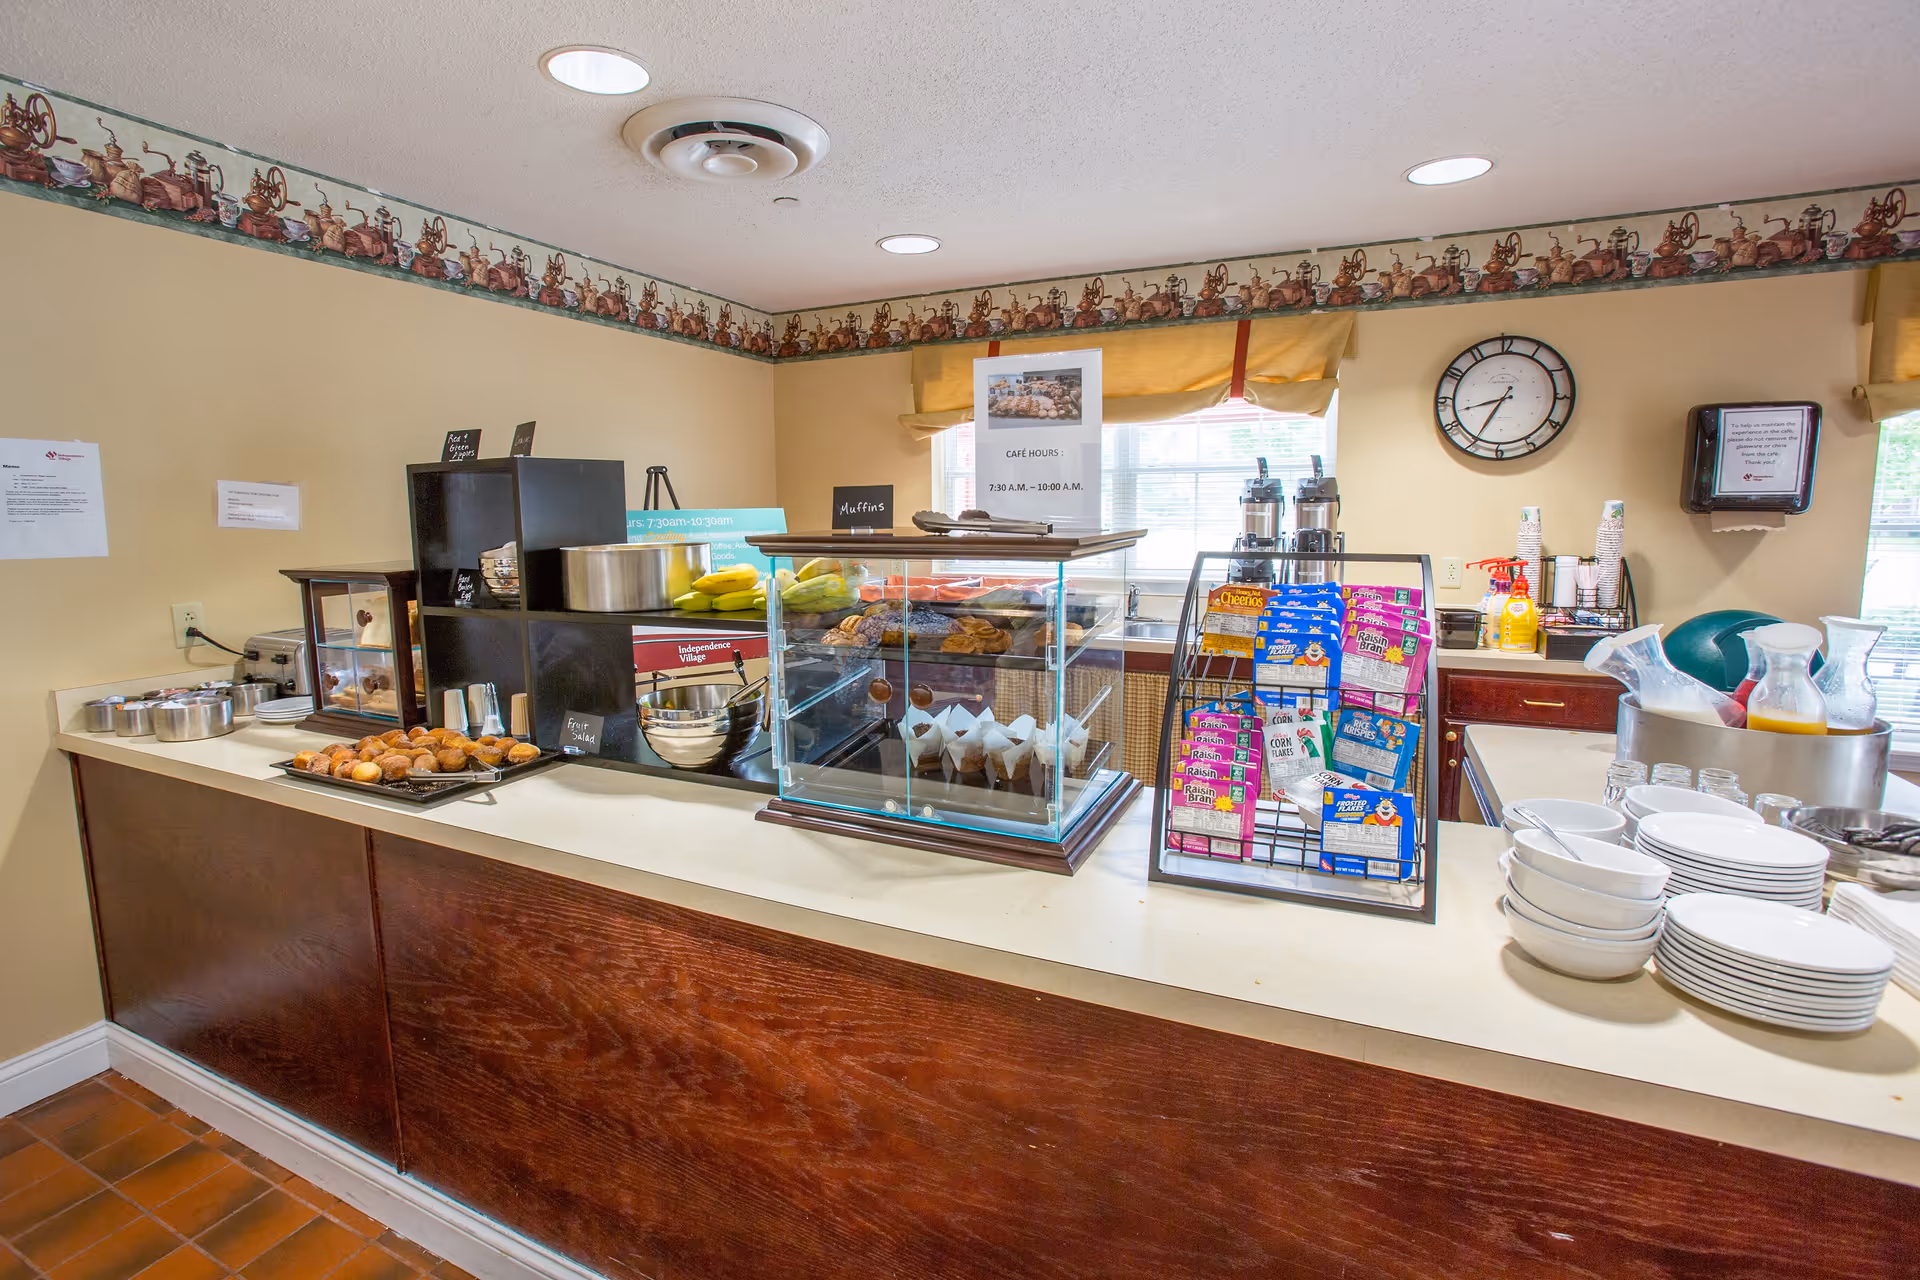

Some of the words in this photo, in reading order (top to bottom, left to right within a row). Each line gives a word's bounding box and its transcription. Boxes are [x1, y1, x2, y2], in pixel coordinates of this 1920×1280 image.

[1501, 338, 1513, 353] 12
[1469, 346, 1485, 362] 11
[1444, 420, 1458, 431] 8
[1548, 418, 1561, 429] 4
[448, 433, 461, 444] Red
[1524, 436, 1536, 451] 5
[449, 444, 469, 452] Green
[1006, 448, 1026, 458] CAFÉ
[1028, 449, 1058, 457] HOURS
[1495, 443, 1504, 459] 6
[452, 449, 475, 460] Apples
[989, 484, 1006, 492] 7:30
[1037, 483, 1061, 491] 10:00
[1063, 482, 1084, 490] A.M.
[840, 501, 885, 515] Muffins
[646, 517, 733, 529] 7:30am-10:30am
[1235, 588, 1250, 596] Honey
[1250, 589, 1261, 597] Nut
[1220, 591, 1264, 608] Cheerios
[1357, 631, 1388, 648] Raisin
[678, 641, 731, 654] Independence
[1359, 641, 1383, 655] Bran
[679, 653, 706, 663] Village
[567, 717, 589, 730] Fruit
[1272, 715, 1293, 725] CORN
[1353, 719, 1370, 730] RICE
[572, 731, 596, 744] Salad
[1343, 724, 1376, 740] KRISPIES
[1270, 737, 1292, 748] CORN
[1193, 750, 1221, 761] Raisin
[1272, 747, 1294, 758] FLAKES
[1188, 767, 1216, 779] Raisin
[1319, 771, 1344, 786] CORN
[1185, 785, 1215, 798] Raisin
[1188, 793, 1212, 805] Bran
